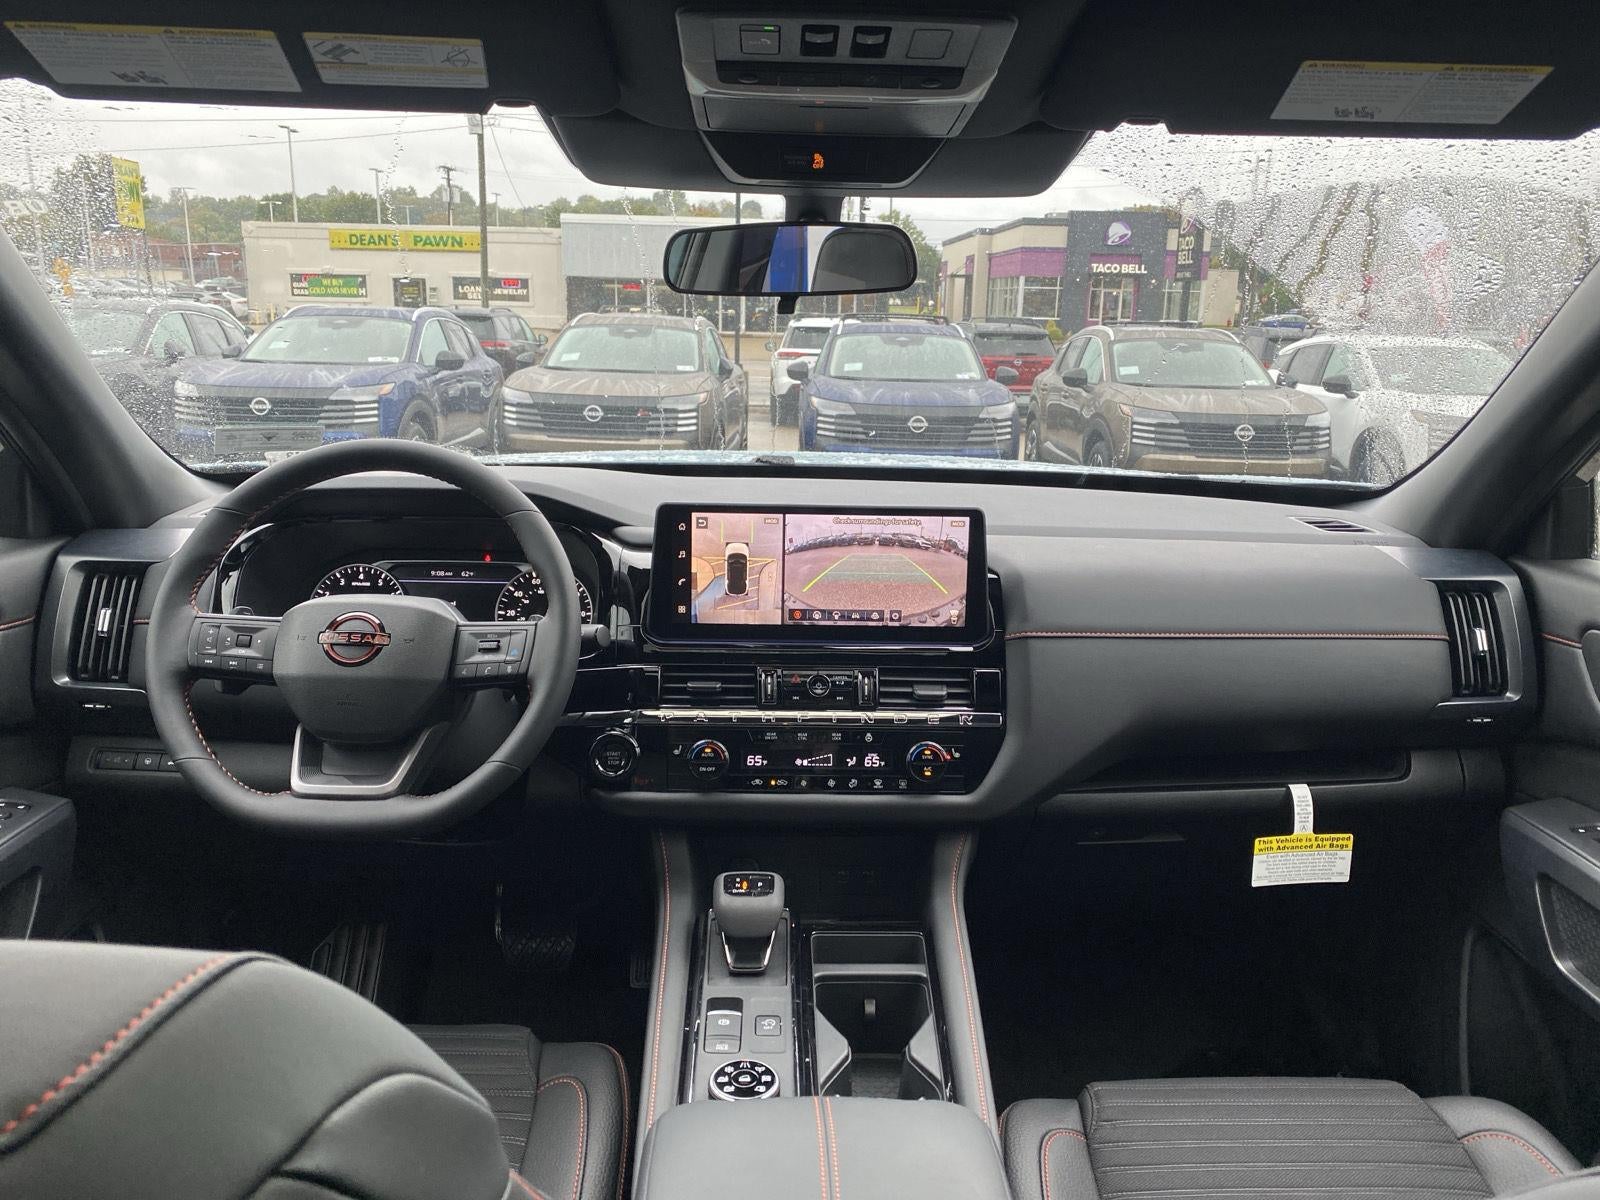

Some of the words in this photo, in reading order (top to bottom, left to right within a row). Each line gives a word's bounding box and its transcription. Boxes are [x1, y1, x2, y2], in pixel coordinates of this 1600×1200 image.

[349, 234, 398, 246] DEAN'S
[413, 235, 464, 247] PAWN
[1179, 236, 1194, 251] TACO
[1178, 250, 1194, 265] BELL
[1091, 263, 1120, 273] TACO
[1121, 264, 1148, 274] BELL
[321, 632, 389, 645] NISSAN
[658, 711, 973, 725] PATHFINDER
[1314, 835, 1351, 843] Equipped
